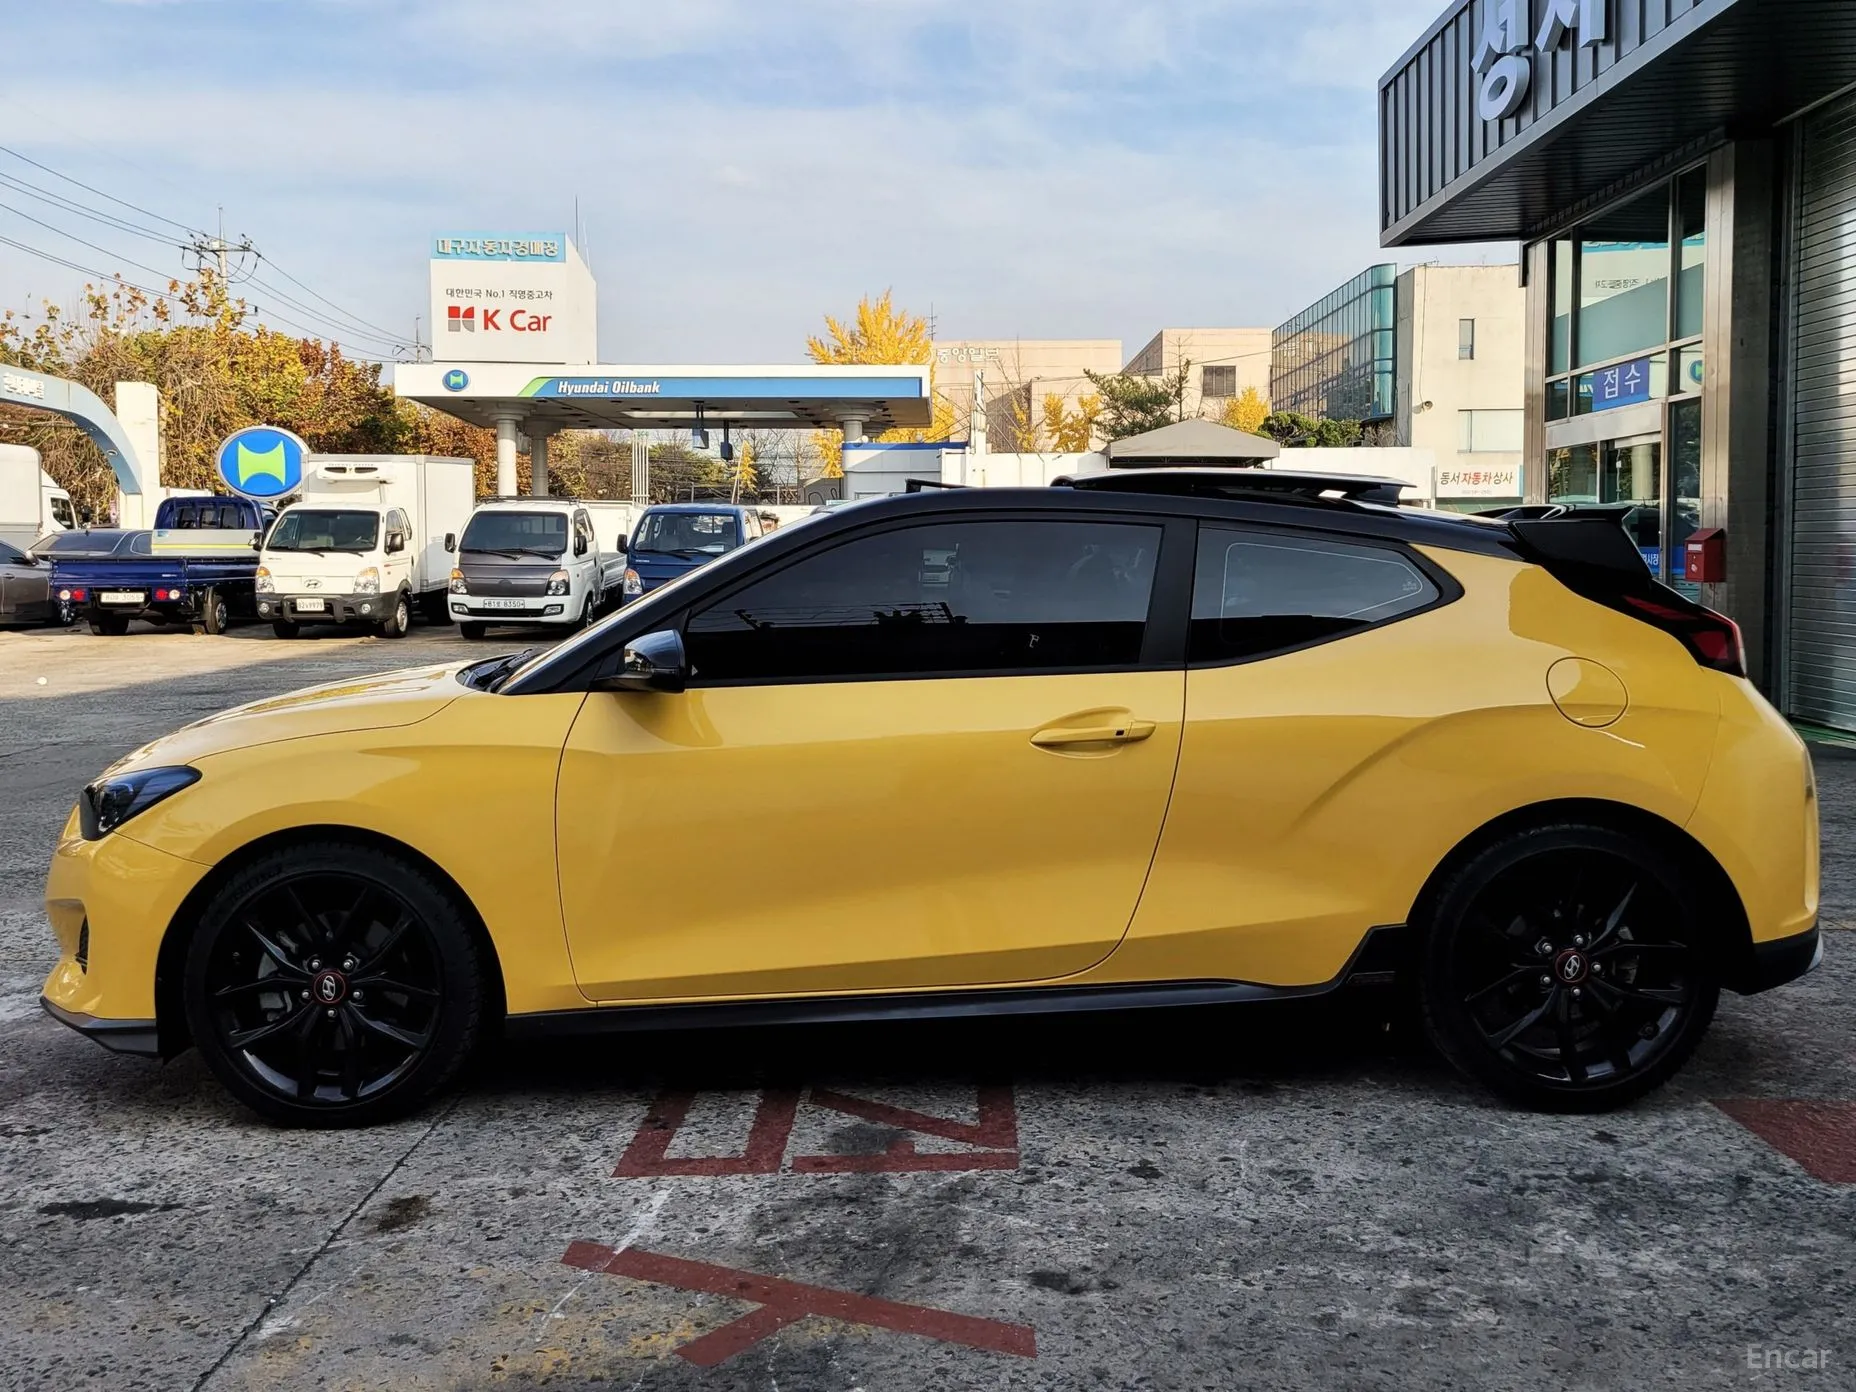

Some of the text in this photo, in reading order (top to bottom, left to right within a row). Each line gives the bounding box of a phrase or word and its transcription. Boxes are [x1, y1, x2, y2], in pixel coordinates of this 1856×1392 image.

[446, 288, 553, 300] 대한민국 No.1 직영중고차
[484, 309, 552, 332] K Car
[937, 346, 1000, 364] 중앙일보
[557, 381, 660, 395] Hyundai Oilbank
[1603, 364, 1641, 399] 접수
